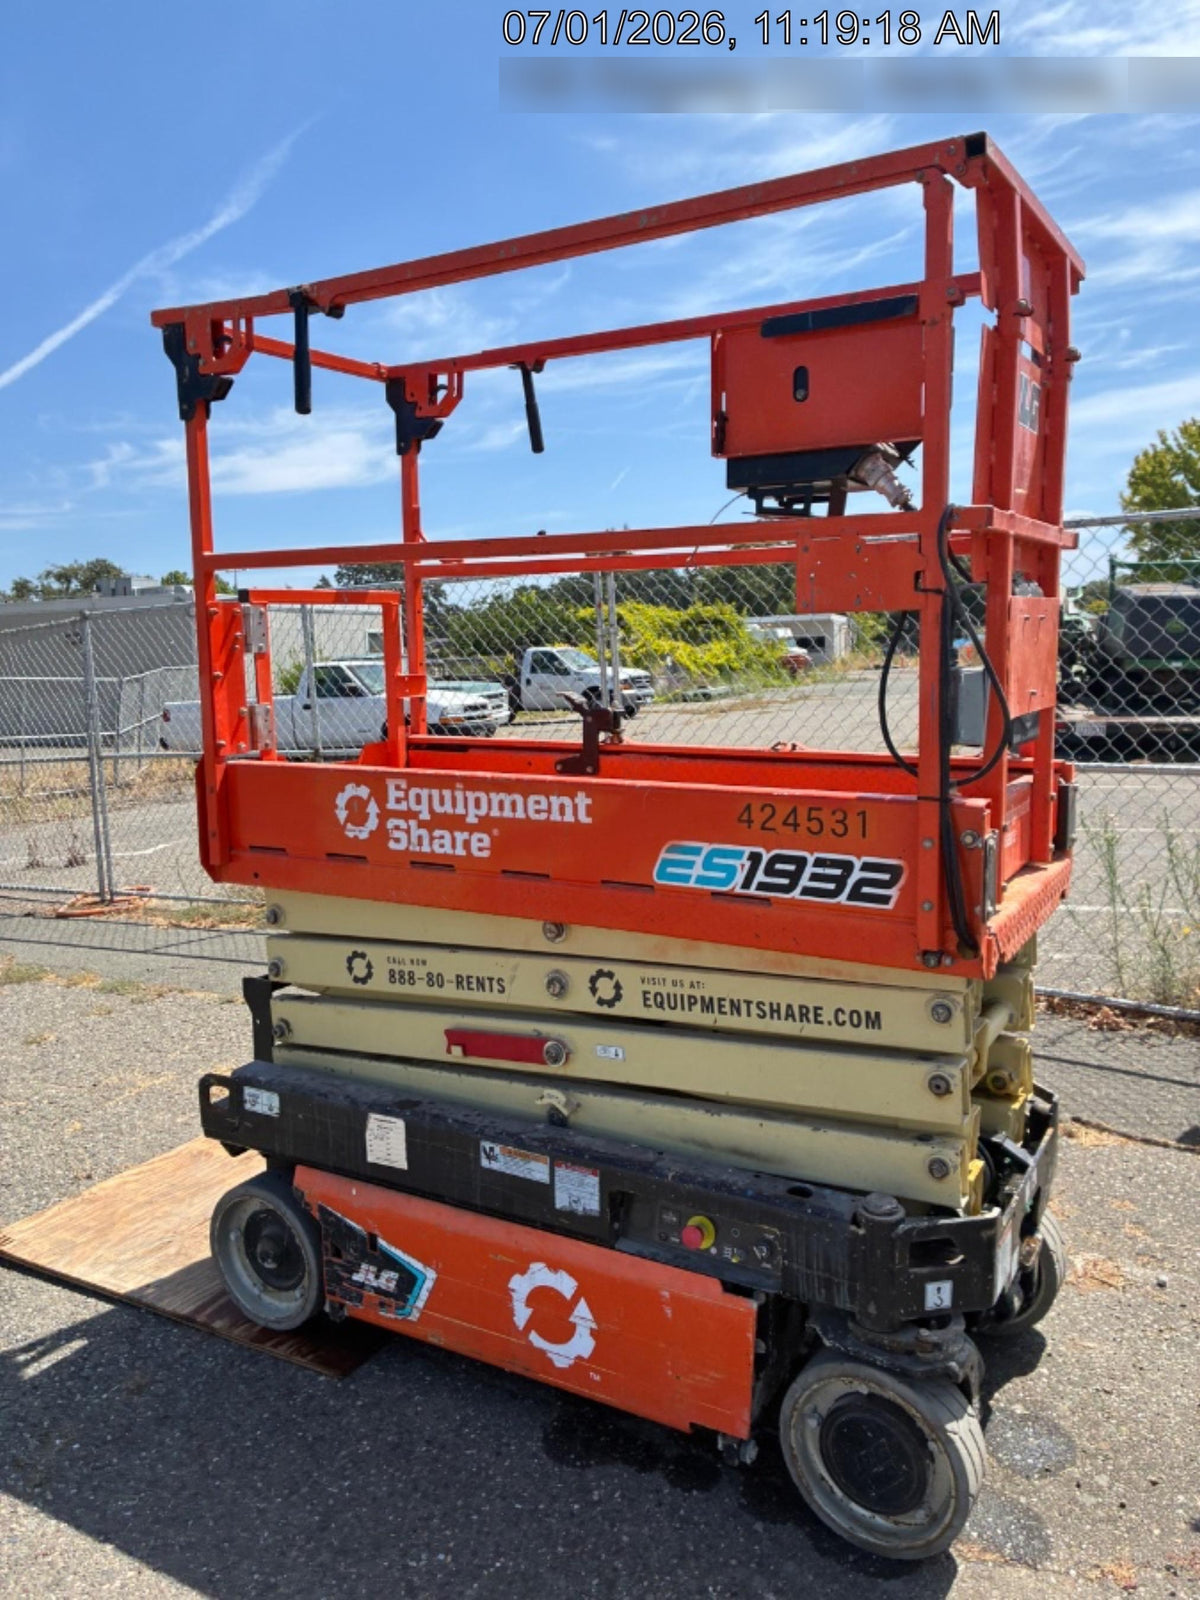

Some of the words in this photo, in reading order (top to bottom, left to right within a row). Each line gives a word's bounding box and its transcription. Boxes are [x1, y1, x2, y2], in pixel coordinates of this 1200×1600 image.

[385, 778, 593, 824] Equipment
[737, 802, 870, 839] 424531
[386, 818, 491, 857] Share
[654, 841, 907, 909] ES1932
[388, 968, 506, 994] 888-80-RENTS
[640, 976, 666, 987] VISIT
[672, 979, 685, 988] US
[689, 980, 705, 989] AT:
[641, 990, 883, 1030] EQUIPMENTSHARE.COM
